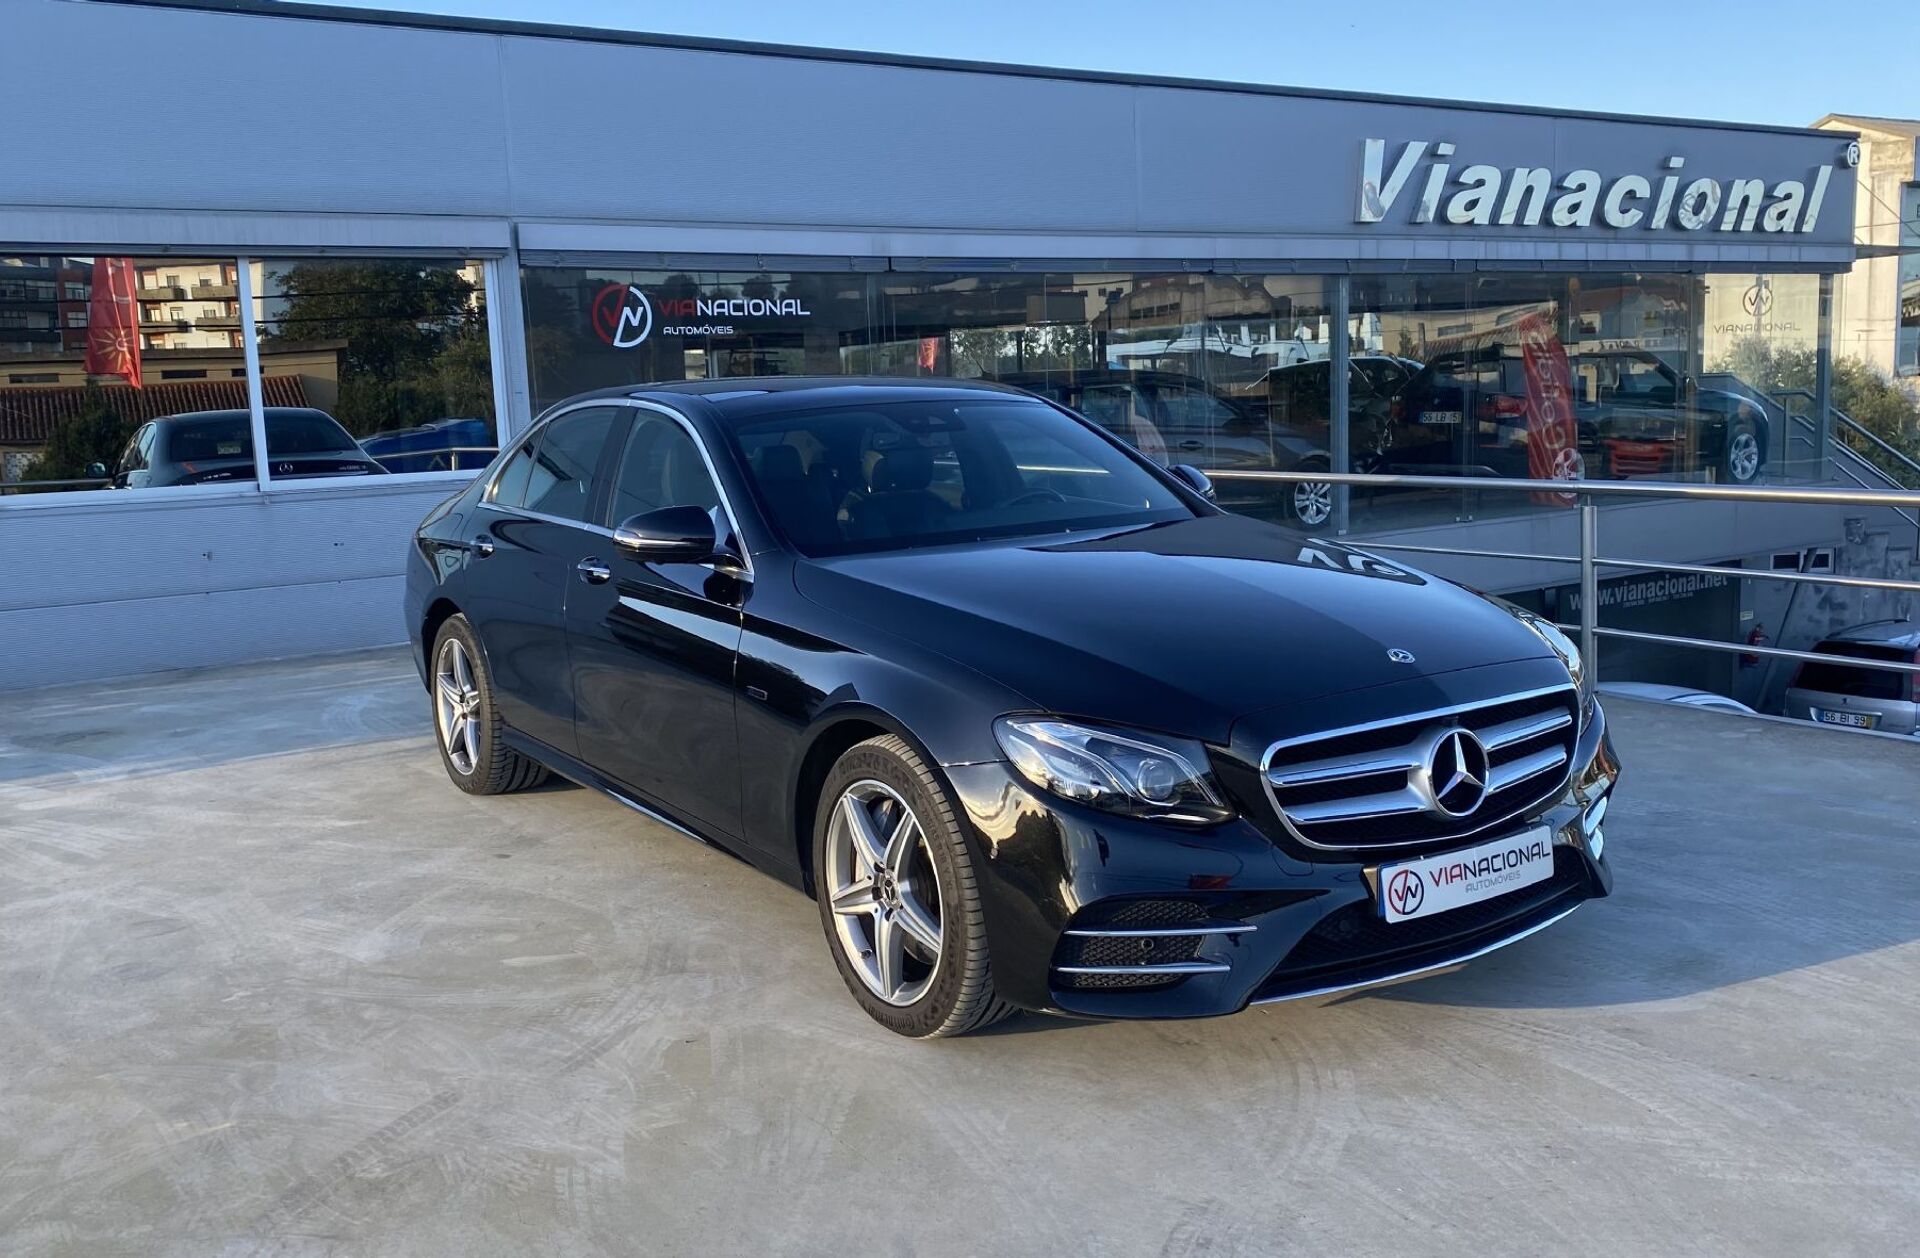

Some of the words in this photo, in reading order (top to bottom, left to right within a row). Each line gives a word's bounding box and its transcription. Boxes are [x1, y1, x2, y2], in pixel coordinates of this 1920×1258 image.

[1359, 138, 1833, 233] Vianacional
[659, 299, 811, 316] VIANACIONAL
[663, 324, 734, 336] AUTOMÓVEIS
[1569, 572, 1728, 611] ww.vianacional.net
[1429, 840, 1551, 888] VIANACIONAL
[1465, 870, 1522, 894] AUTOMÓVEIS
